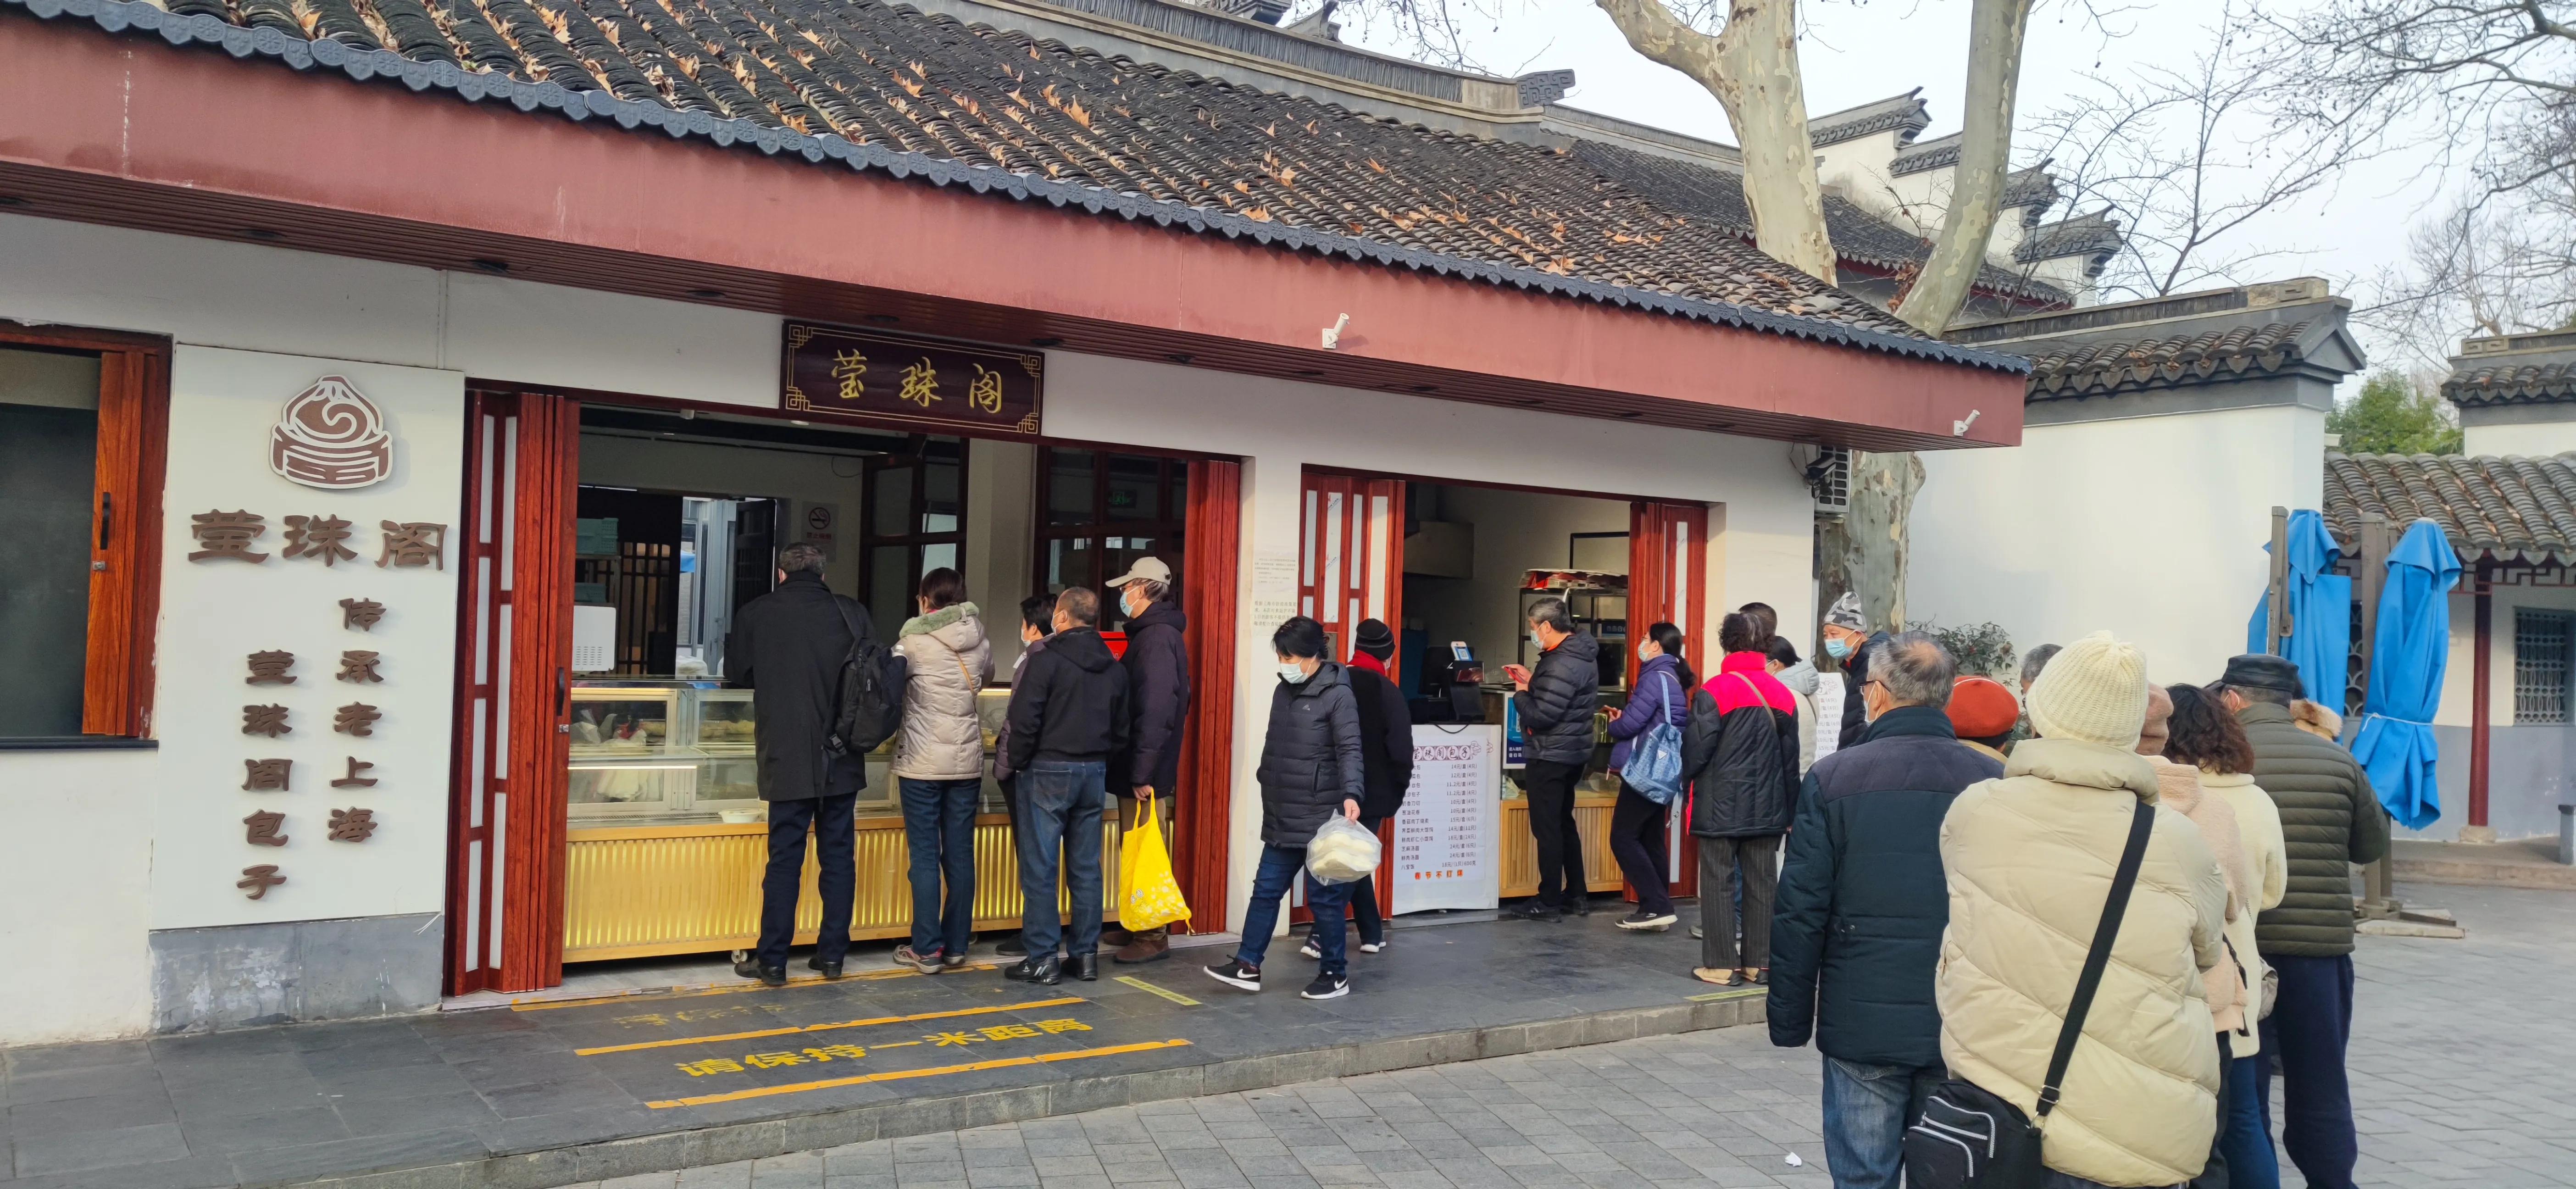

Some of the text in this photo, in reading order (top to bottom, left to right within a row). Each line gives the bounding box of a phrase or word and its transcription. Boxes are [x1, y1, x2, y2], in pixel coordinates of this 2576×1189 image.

[831, 348, 1002, 414] 莹珠阁
[188, 509, 448, 571] 莹珠阁
[327, 597, 387, 843] 传承老上海
[236, 649, 298, 900] 莹珠阁包子
[677, 1017, 1094, 1077] 请保持一米距离
